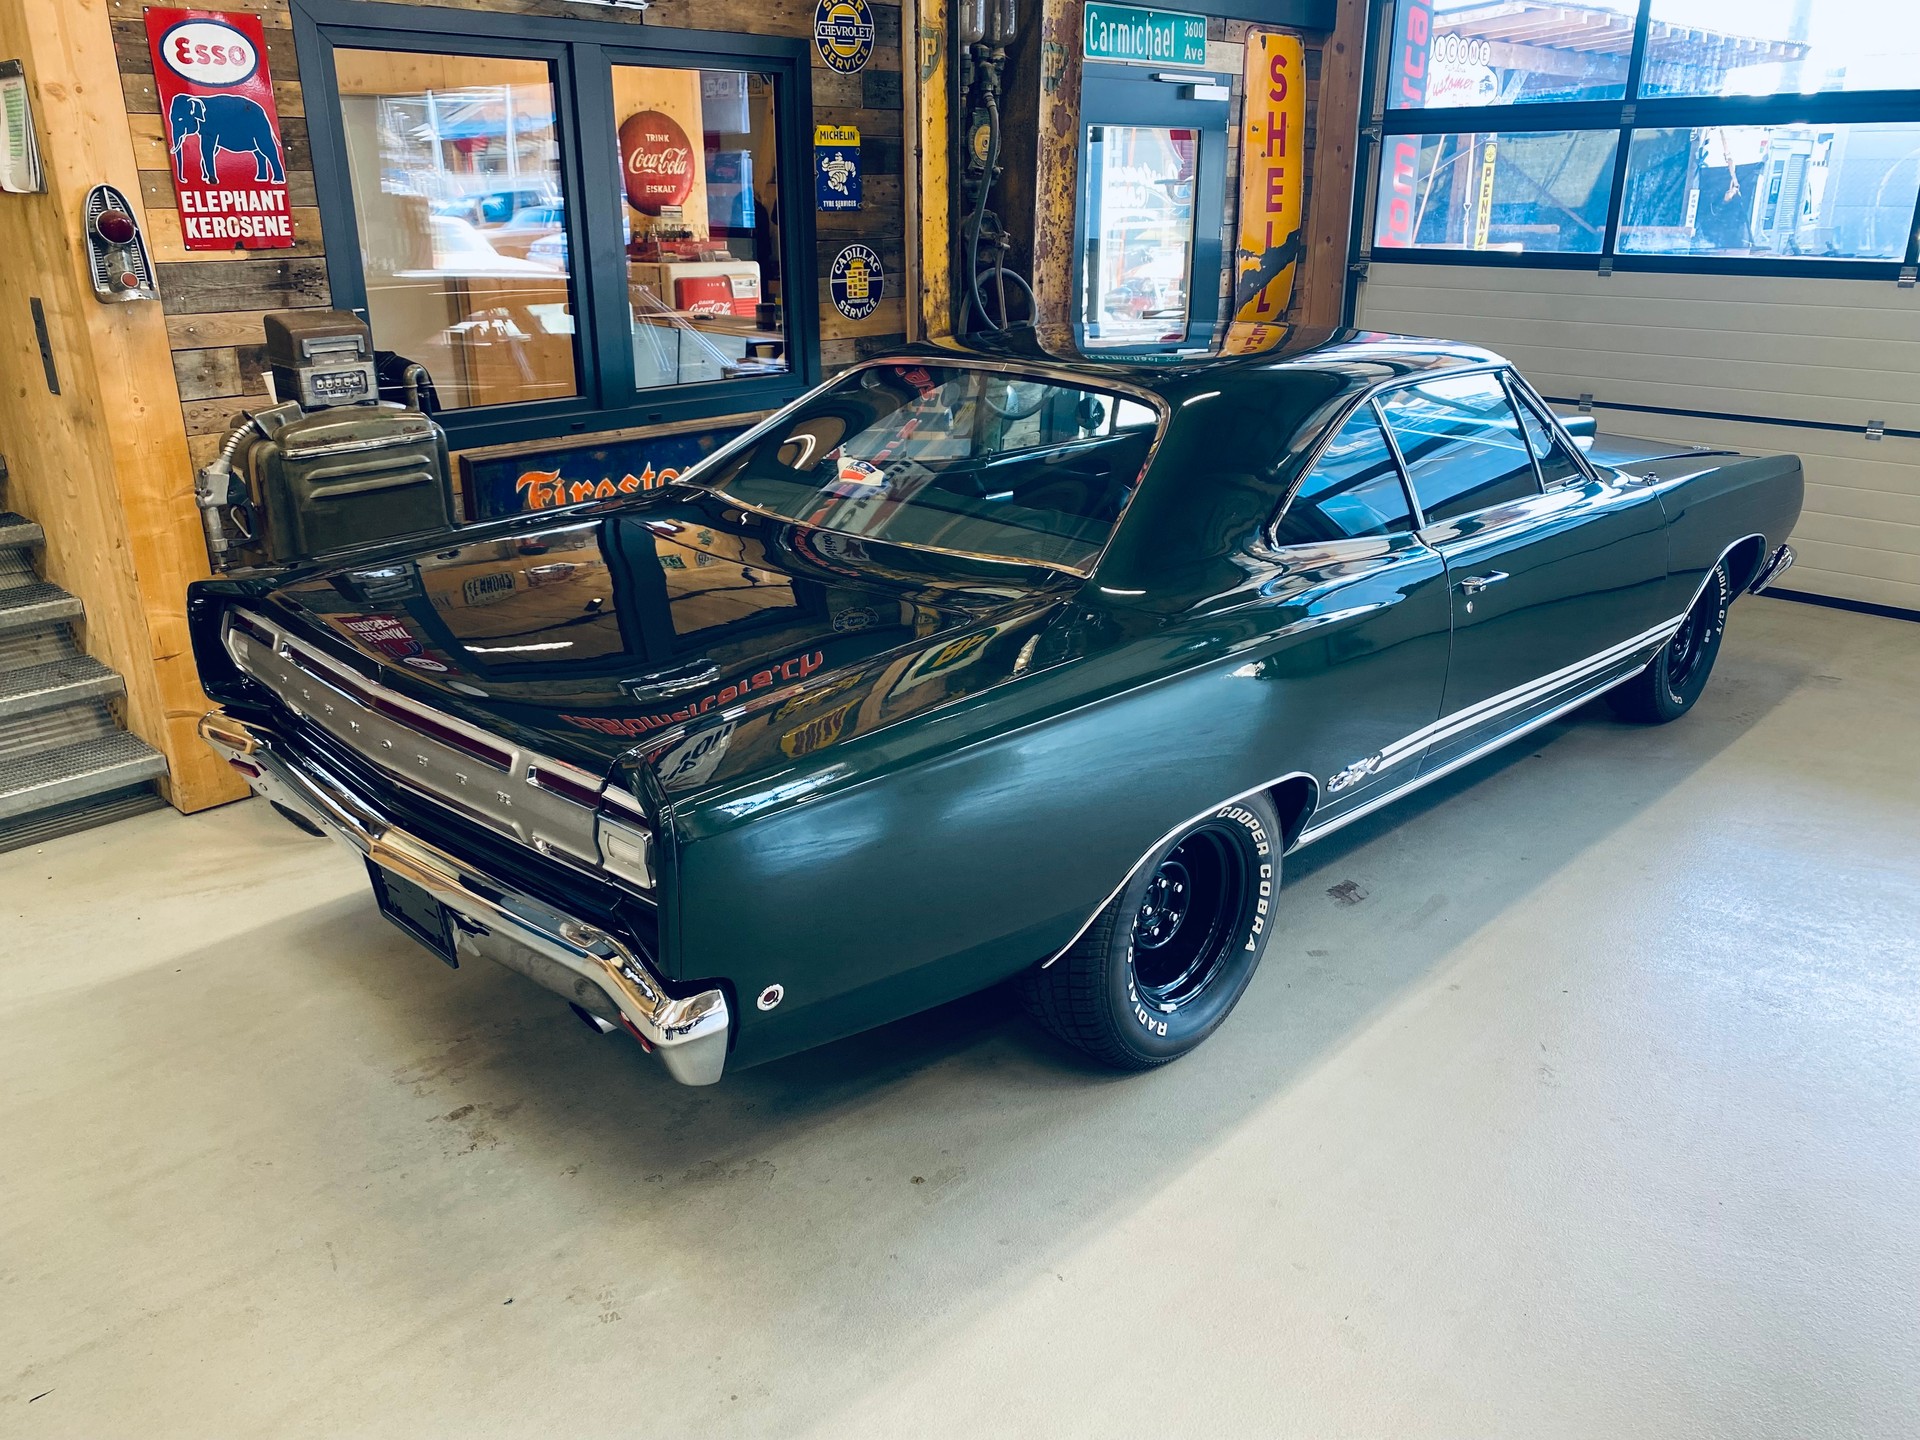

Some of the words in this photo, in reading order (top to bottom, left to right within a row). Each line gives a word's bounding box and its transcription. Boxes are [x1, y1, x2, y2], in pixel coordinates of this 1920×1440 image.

[820, 25, 870, 38] CHEVROLET
[1089, 11, 1175, 59] Carmichael
[1184, 20, 1204, 38] 3600
[175, 37, 247, 67] Esso
[822, 45, 868, 70] SERVICE
[1184, 44, 1204, 60] Ave
[645, 133, 670, 142] TRINK
[820, 131, 855, 141] MICHELIN
[628, 146, 688, 175] Coca-Cola
[646, 185, 676, 193] EISKALT
[180, 190, 286, 213] ELEPHANT
[184, 215, 292, 239] KEROSENE
[834, 247, 880, 275] CADILLAC
[838, 297, 877, 318] SERVICE
[1714, 564, 1727, 606] RADIAL
[1217, 806, 1270, 856] COOPER
[1244, 864, 1272, 952] COBRA
